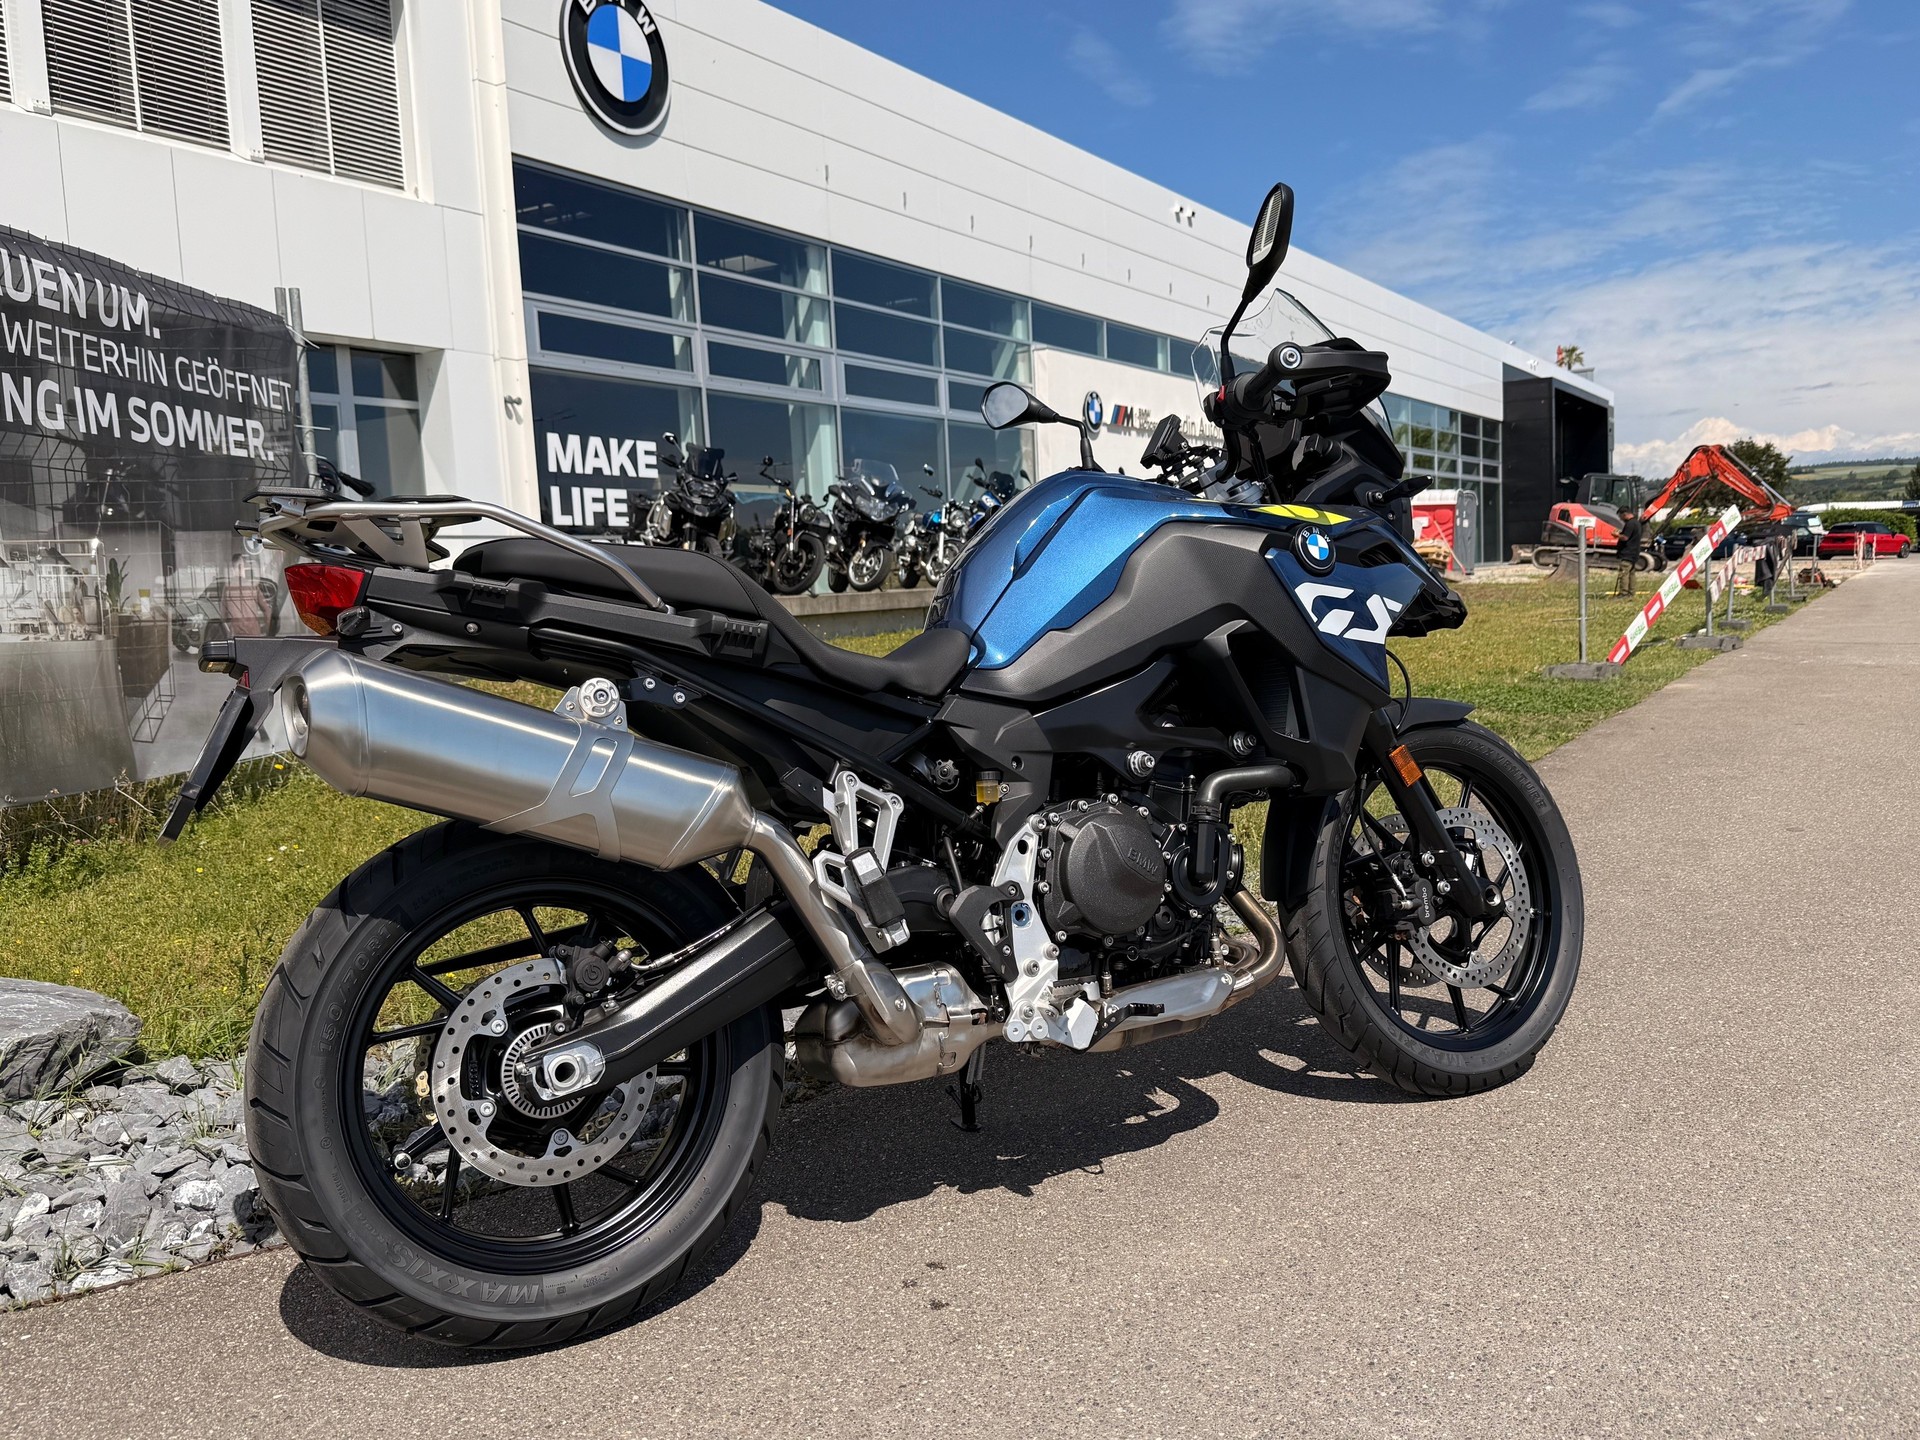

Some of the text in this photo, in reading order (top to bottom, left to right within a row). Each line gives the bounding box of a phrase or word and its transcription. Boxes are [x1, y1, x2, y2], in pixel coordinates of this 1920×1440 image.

[0, 248, 161, 340] UEN UM.
[1, 312, 292, 412] WEITERHIN GEÖFFNET
[74, 386, 121, 438] IM
[128, 396, 275, 462] SOMMER.
[546, 432, 659, 479] MAKE
[550, 486, 630, 527] LIFE
[1302, 527, 1332, 543] BMW
[1294, 582, 1403, 645] GS
[1127, 847, 1159, 876] BMW
[1421, 886, 1430, 918] brembo
[387, 1242, 540, 1305] MAXXIS
